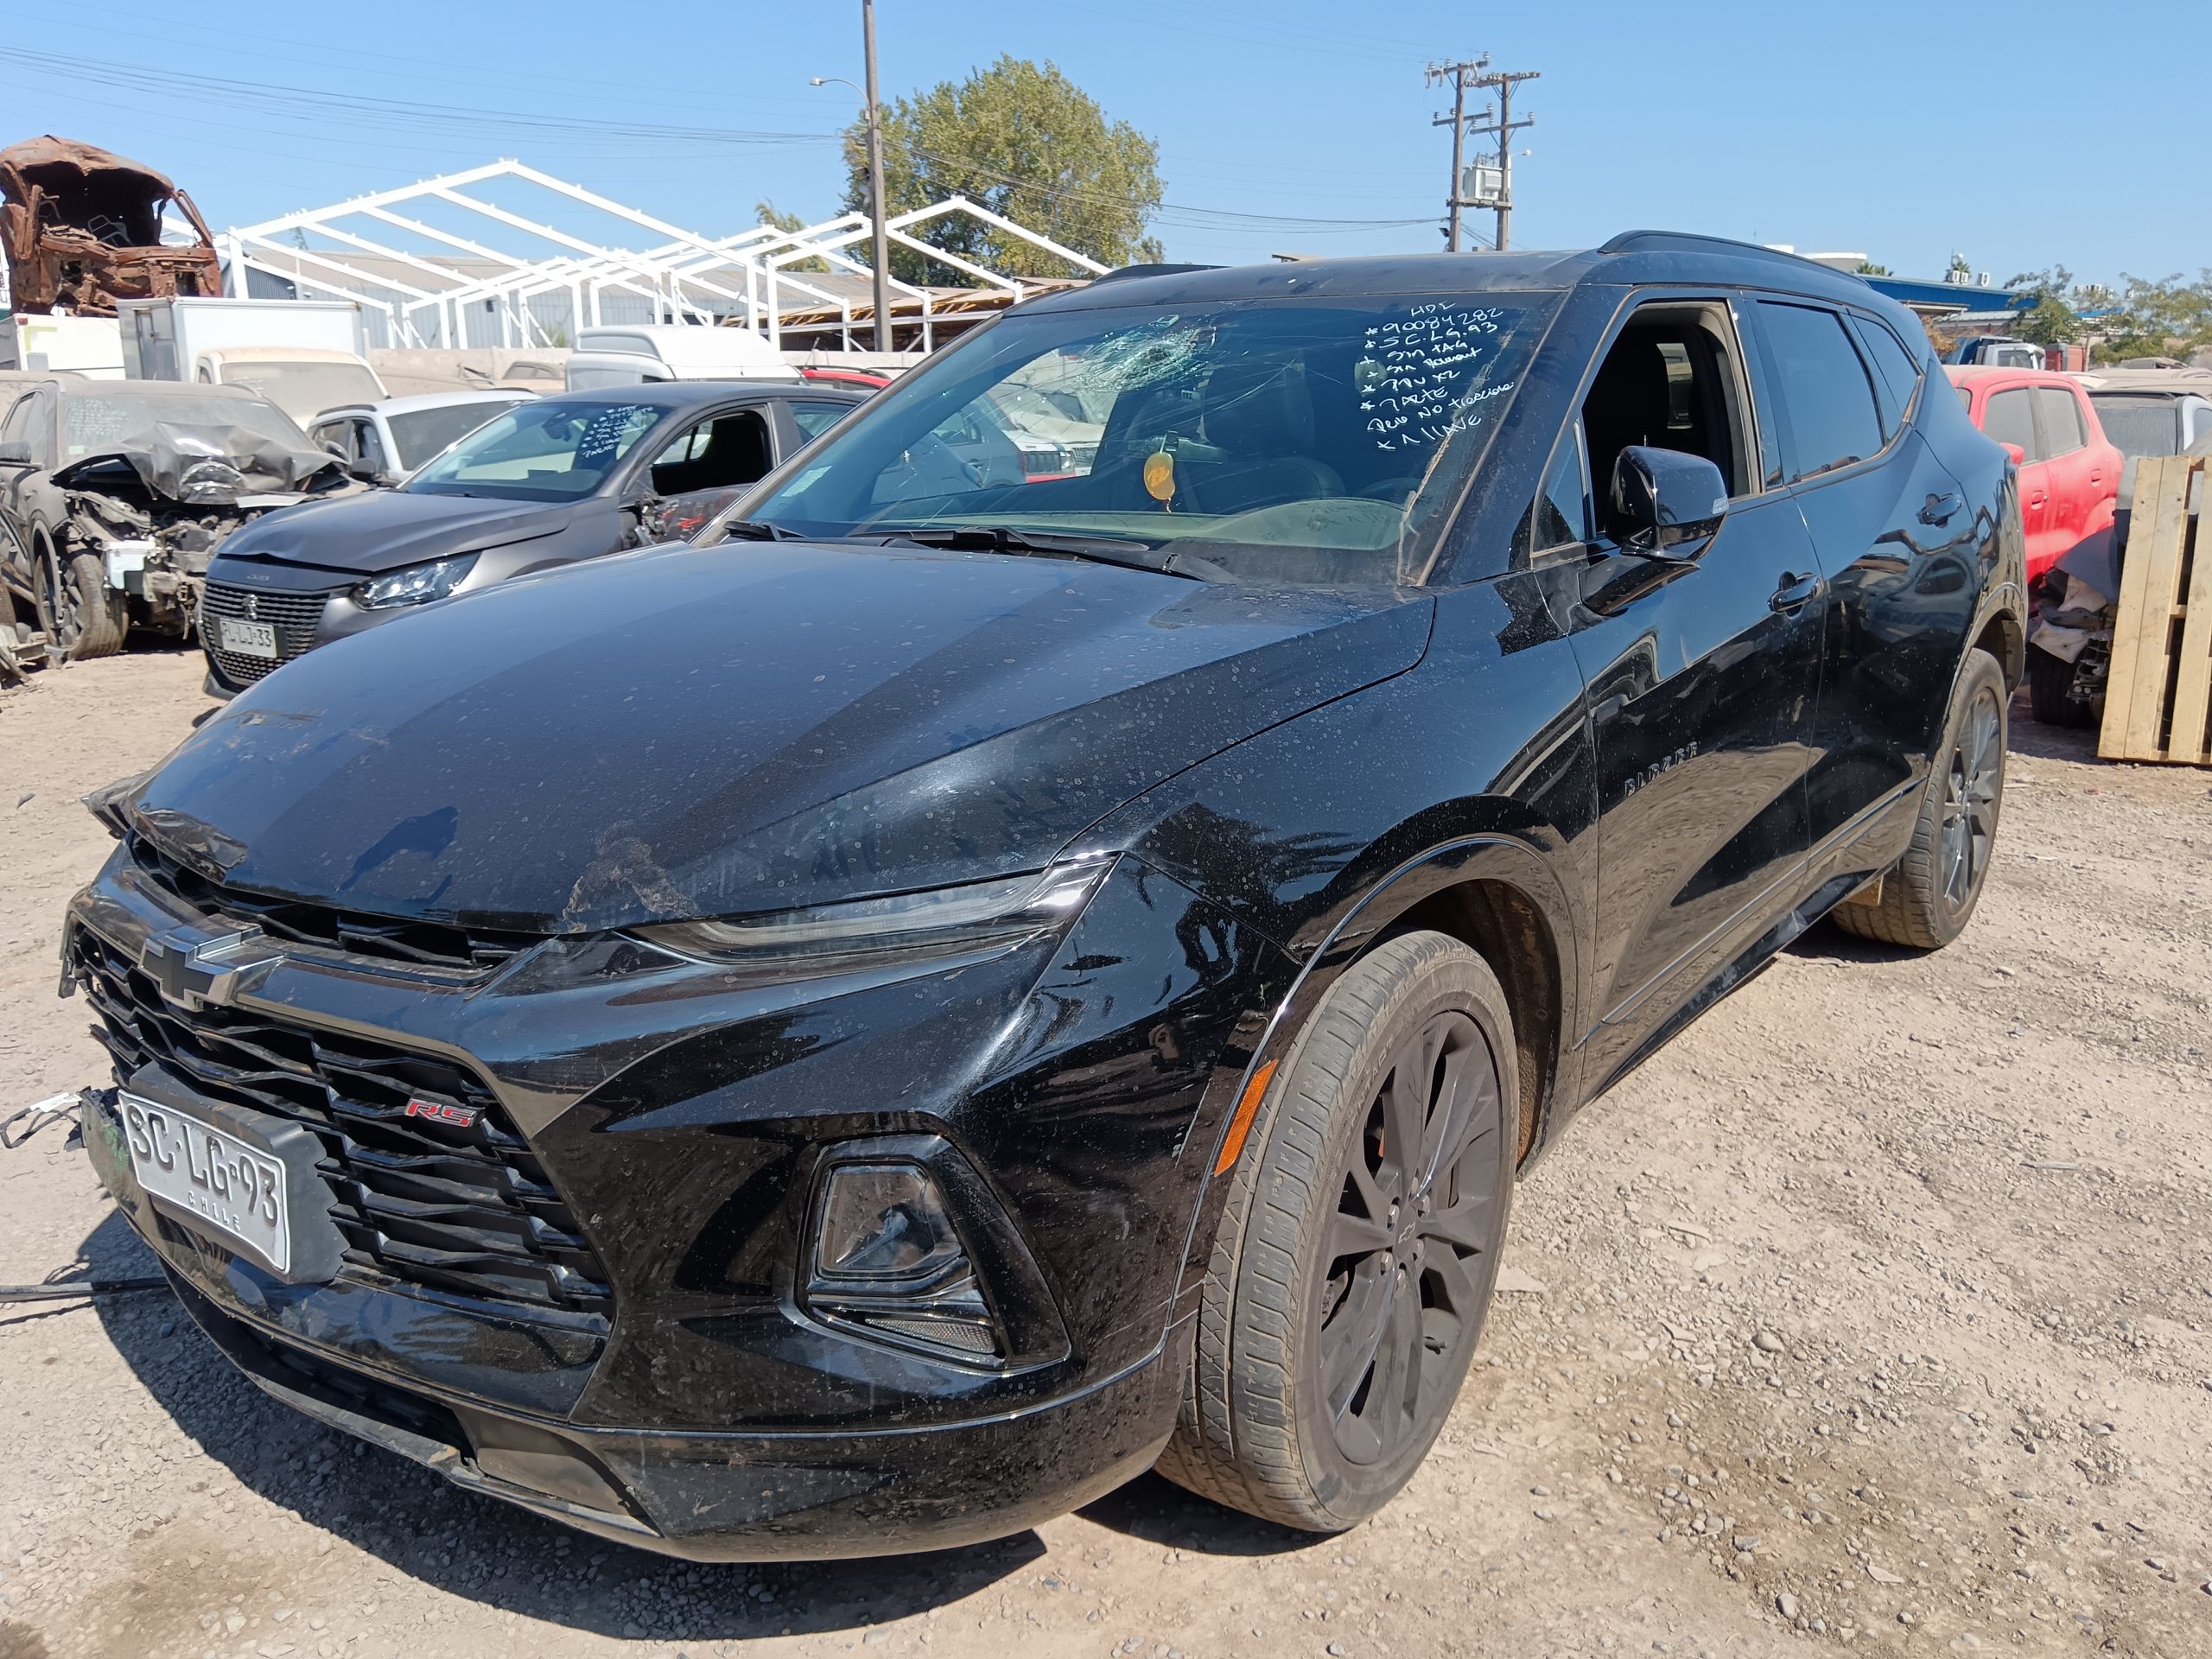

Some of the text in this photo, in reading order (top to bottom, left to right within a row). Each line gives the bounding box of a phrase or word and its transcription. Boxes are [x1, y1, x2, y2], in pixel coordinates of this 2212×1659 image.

[1382, 308, 1503, 334] 90084282
[404, 1097, 477, 1128] RS
[188, 1190, 241, 1232] CHILE
